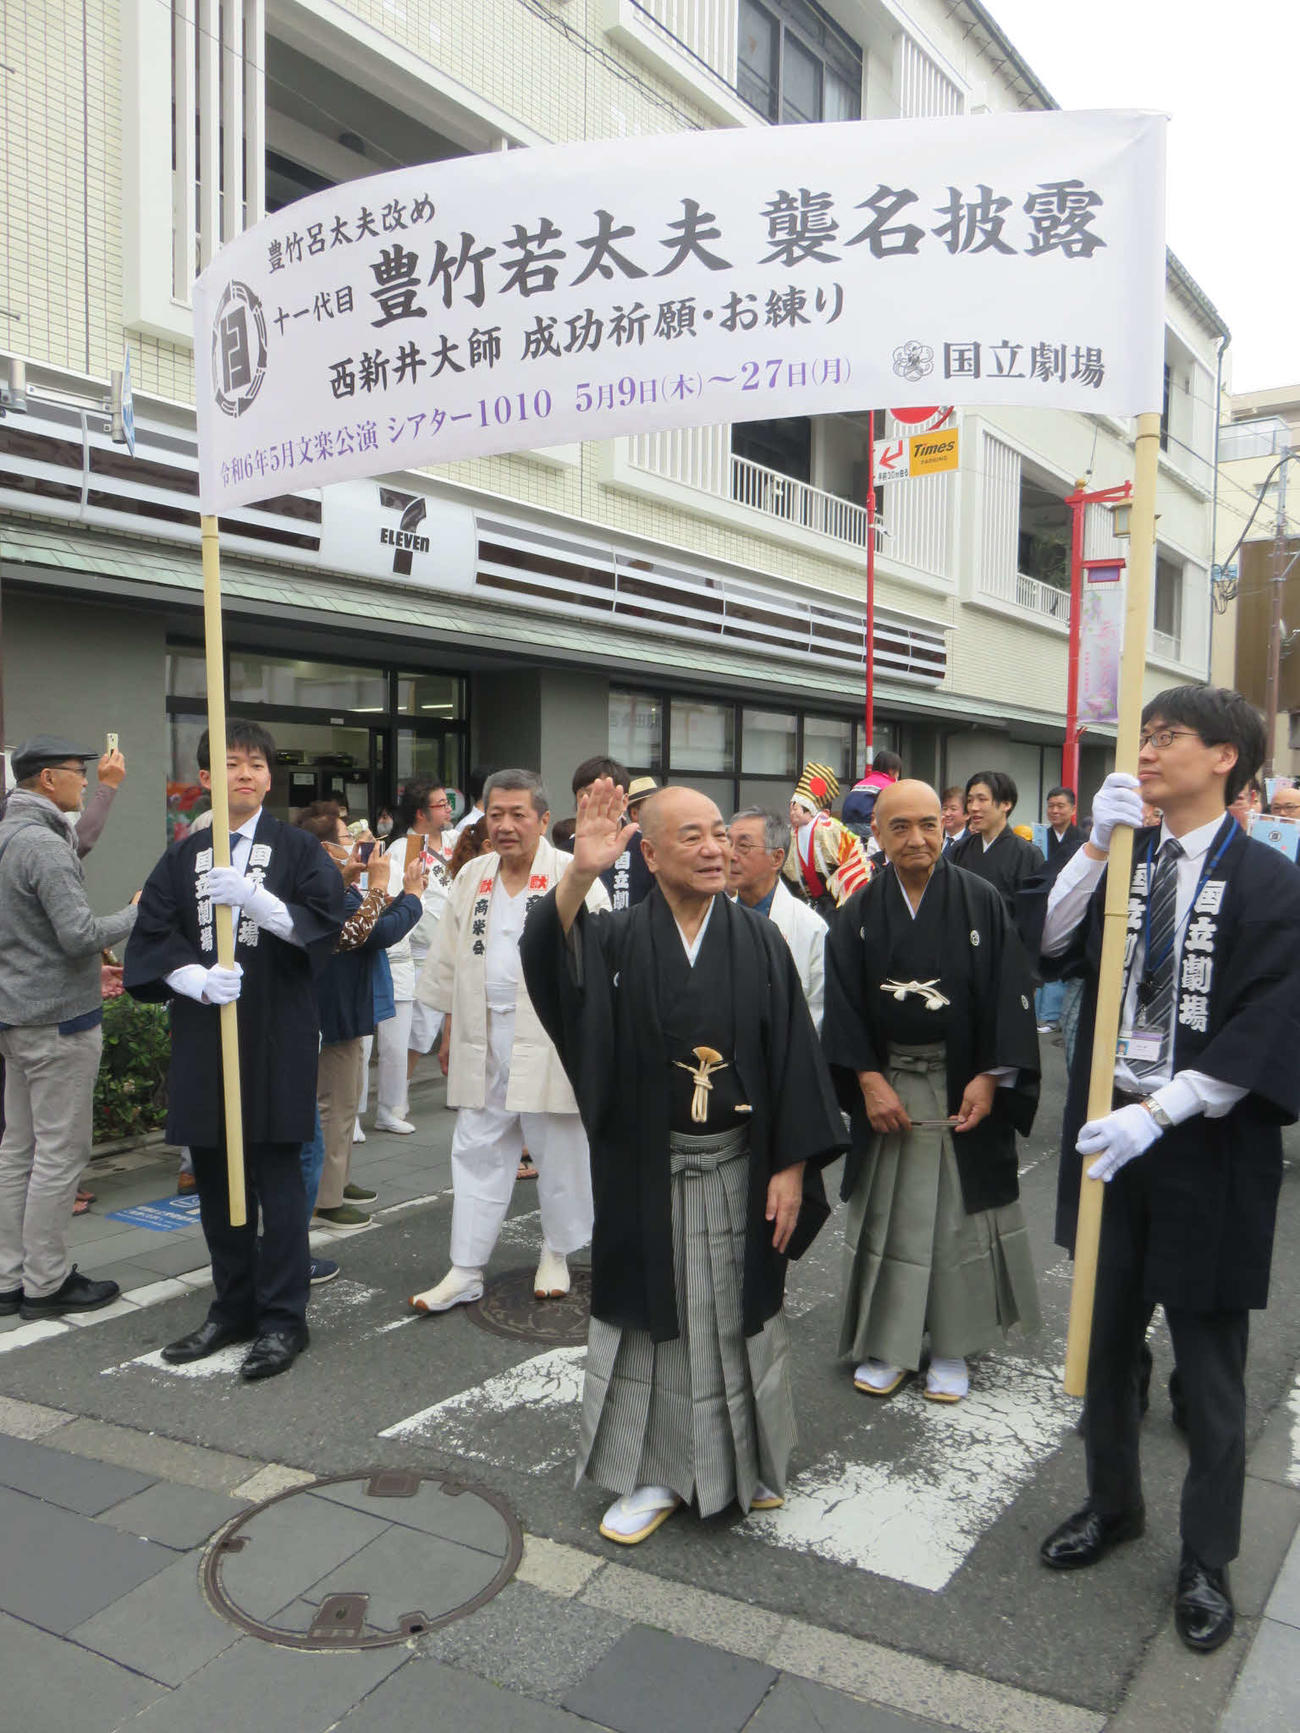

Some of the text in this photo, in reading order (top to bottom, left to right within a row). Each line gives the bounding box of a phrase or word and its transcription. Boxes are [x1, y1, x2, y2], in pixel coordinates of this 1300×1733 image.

[268, 193, 436, 274] 豊竹呂太夫改め
[273, 179, 1108, 336] 十一代目 豊竹若太夫 襲名披露
[328, 282, 844, 400] 西新井大師 成功祈願・お練り
[943, 339, 1106, 389] 国立劇場
[220, 420, 379, 488] 令和6年5月文楽公演
[387, 388, 552, 443] シアター1010
[913, 441, 955, 458] Times
[379, 487, 427, 576] 7
